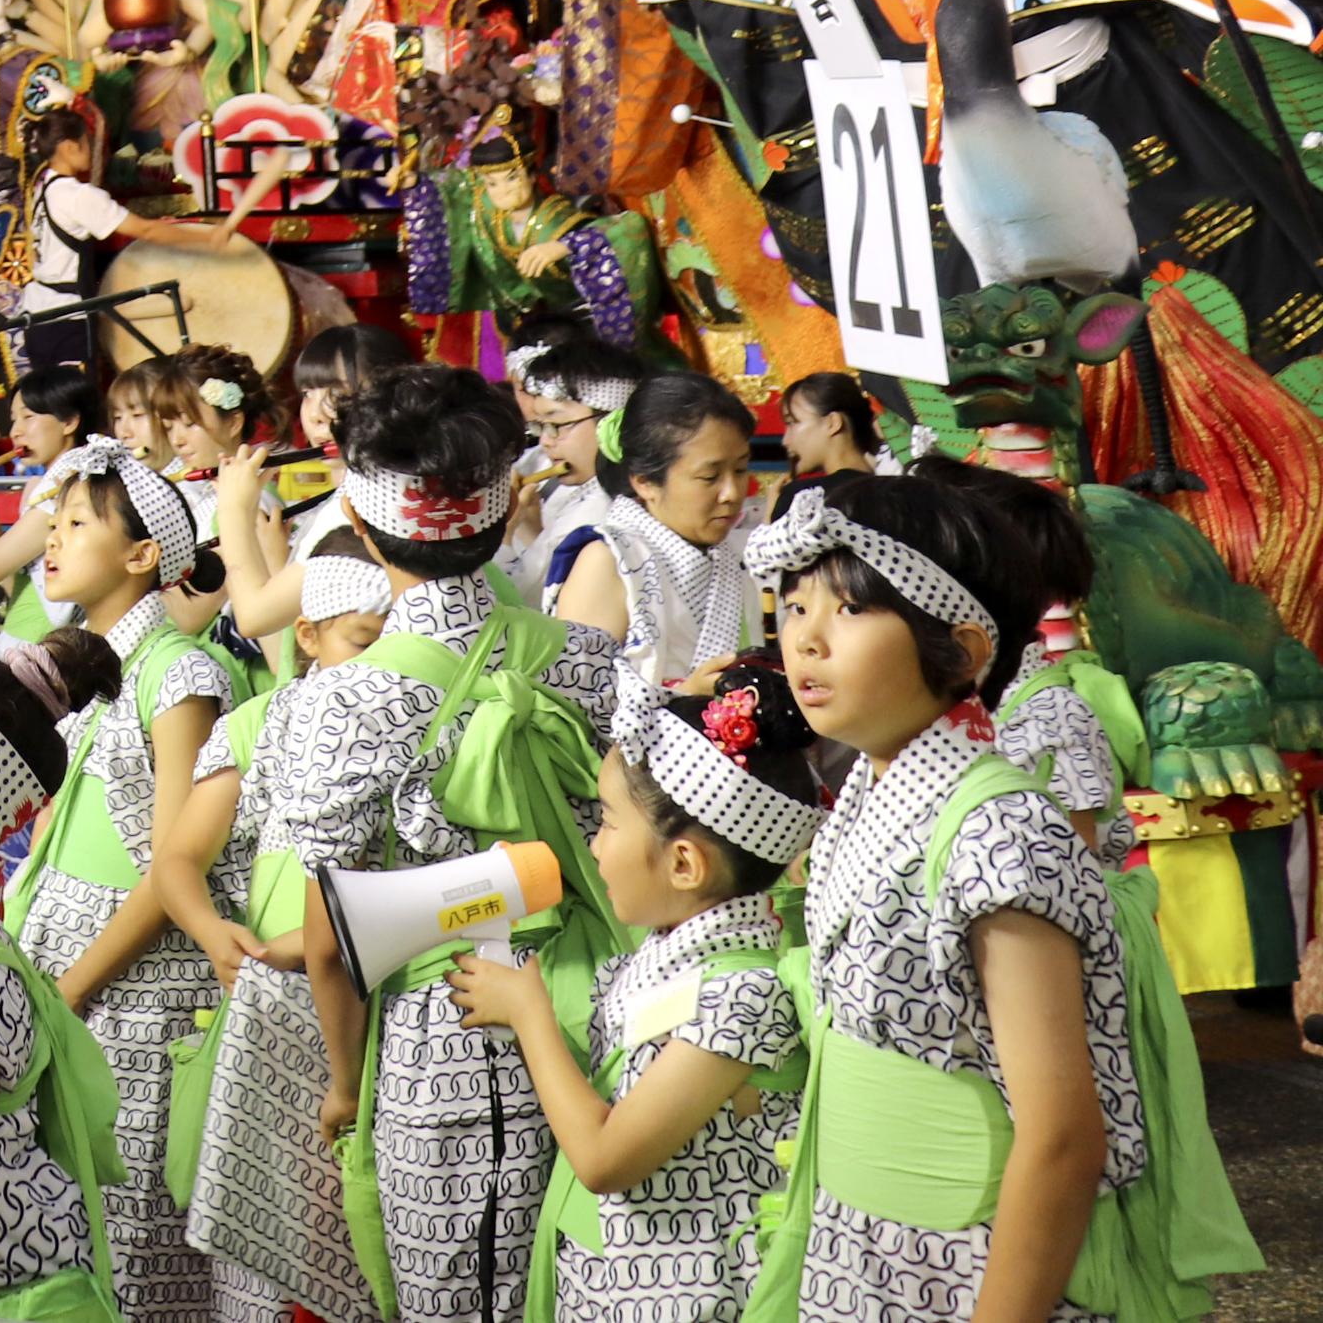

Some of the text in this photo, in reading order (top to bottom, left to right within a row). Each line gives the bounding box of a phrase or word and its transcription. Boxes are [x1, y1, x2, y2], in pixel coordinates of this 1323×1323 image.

[832, 102, 925, 339] 21
[447, 899, 500, 928] 八戸市
